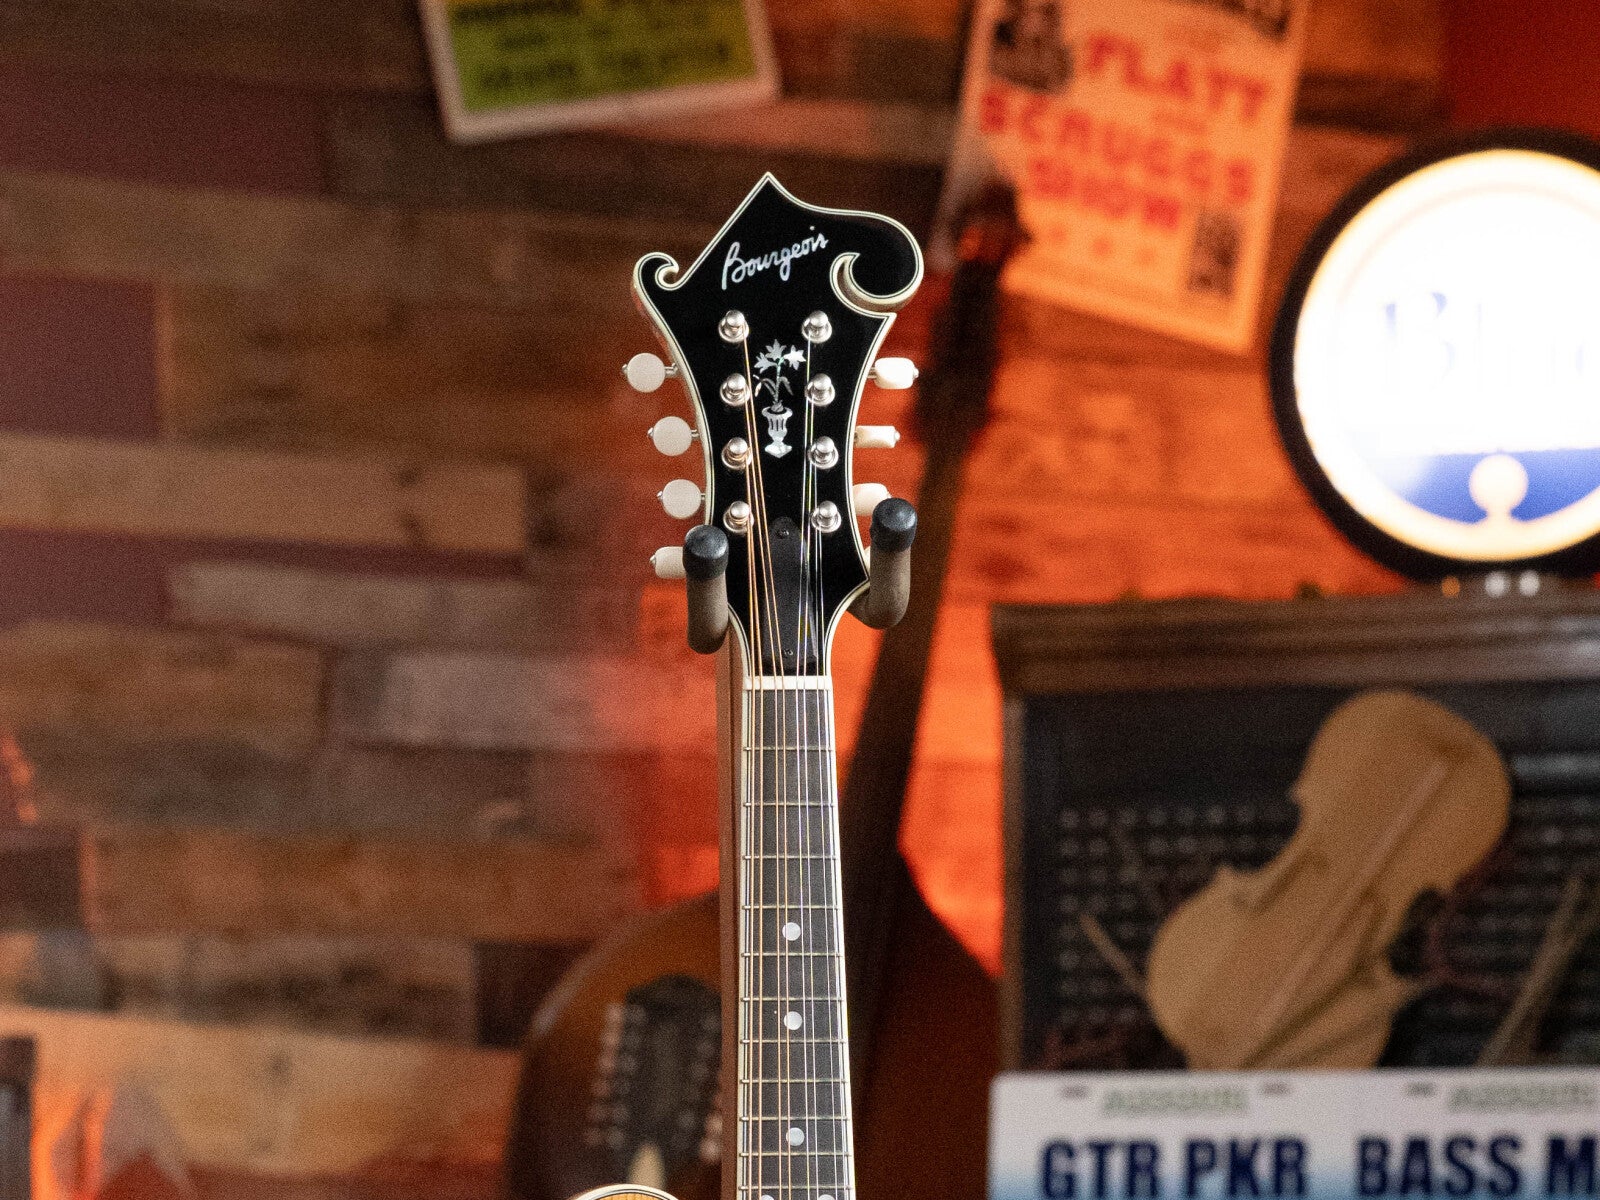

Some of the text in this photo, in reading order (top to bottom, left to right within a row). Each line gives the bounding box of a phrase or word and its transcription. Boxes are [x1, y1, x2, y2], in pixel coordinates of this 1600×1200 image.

[721, 225, 829, 290] Bourgeois
[1041, 1138, 1306, 1200] GTR PKR
[1358, 1134, 1521, 1198] BASS
